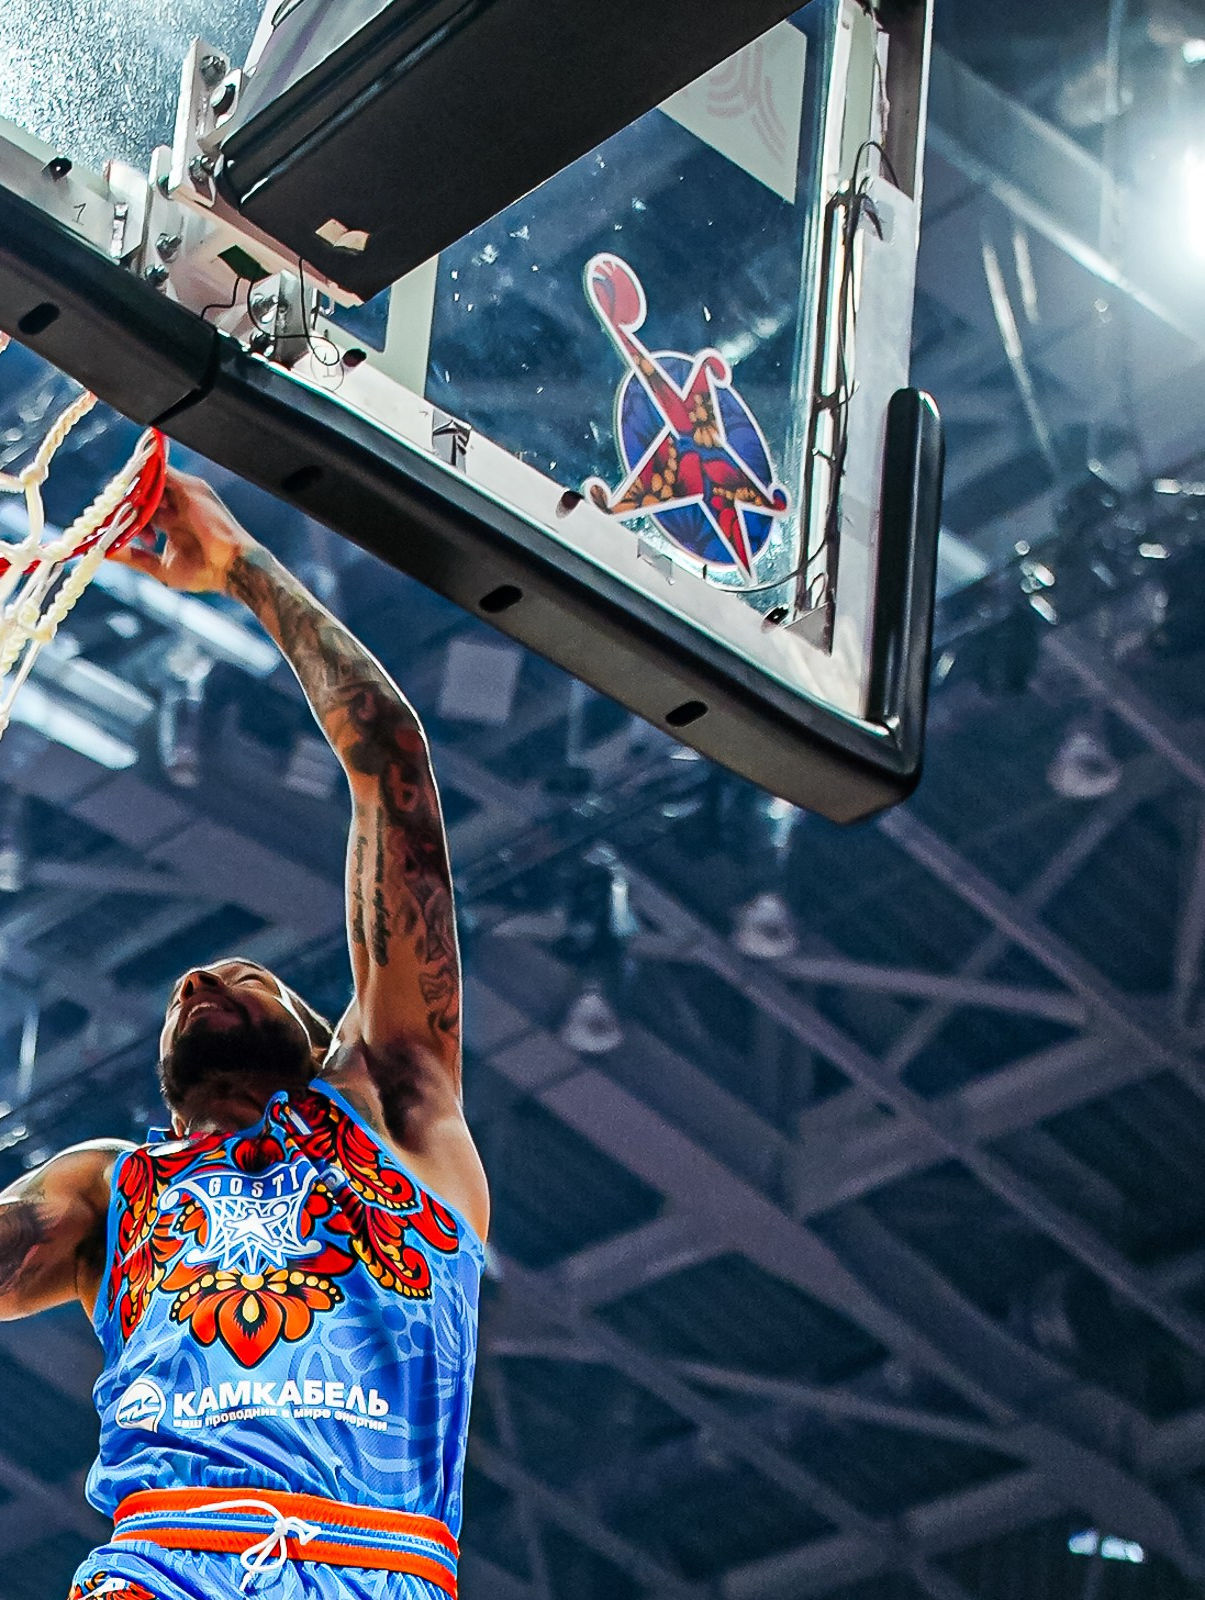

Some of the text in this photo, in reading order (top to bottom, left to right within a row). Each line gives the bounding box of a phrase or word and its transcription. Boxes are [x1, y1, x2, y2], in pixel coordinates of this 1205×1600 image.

[208, 1165, 300, 1198] GOSTI
[173, 1379, 390, 1418] КАМКАБЕЛЬ
[205, 1407, 278, 1428] проводник
